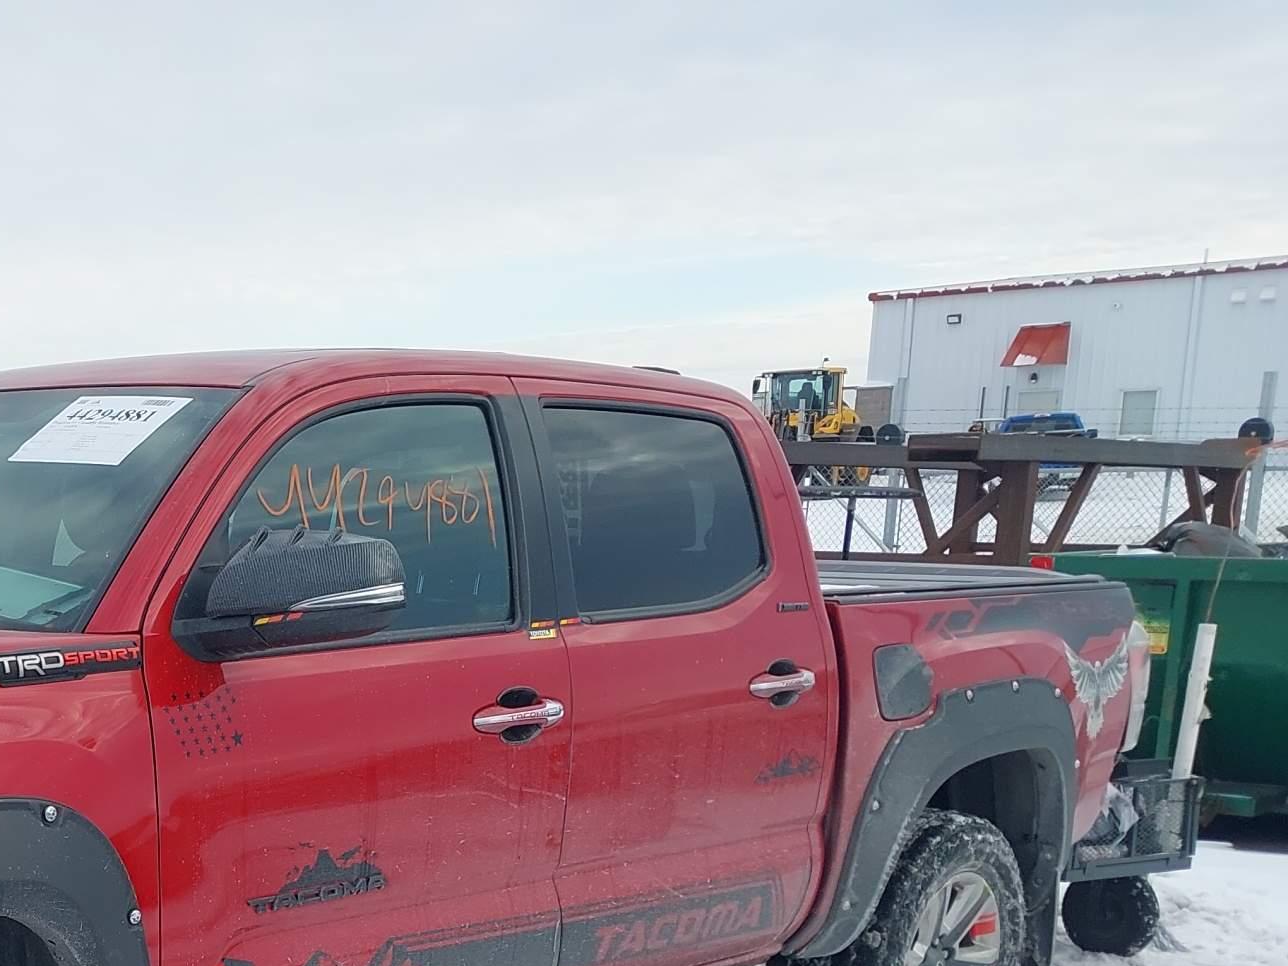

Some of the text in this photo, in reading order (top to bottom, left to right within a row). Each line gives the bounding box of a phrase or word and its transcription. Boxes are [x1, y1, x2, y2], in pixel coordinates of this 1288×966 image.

[66, 408, 158, 422] 44294881
[63, 647, 141, 666] SPORT
[247, 874, 386, 914] TACOMA
[595, 895, 764, 963] TACOMA
